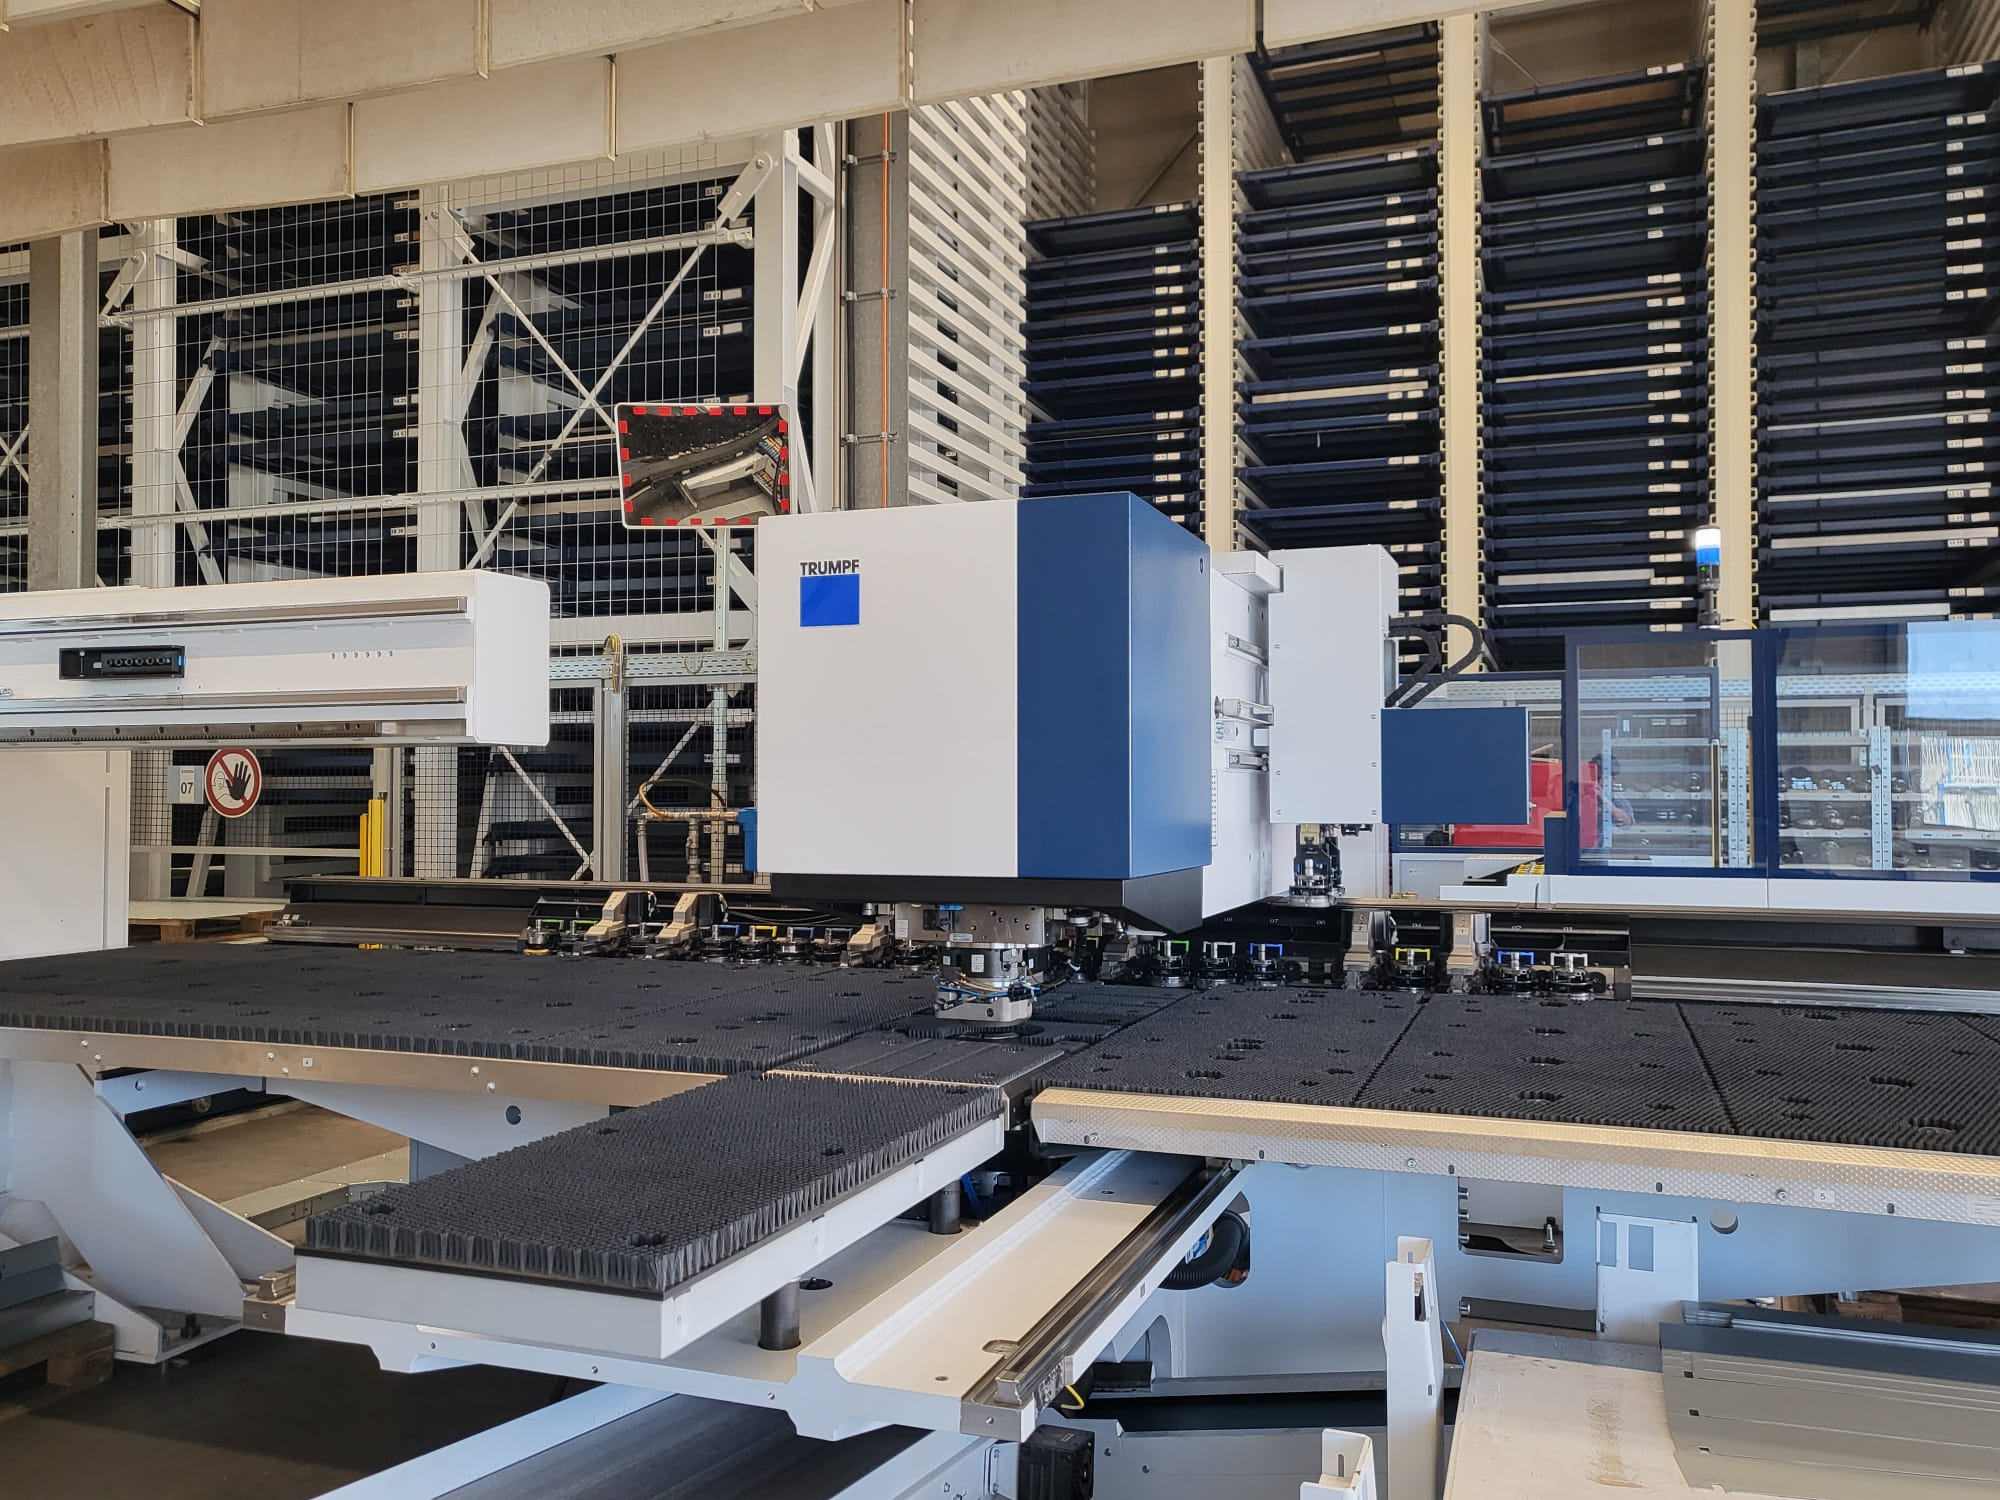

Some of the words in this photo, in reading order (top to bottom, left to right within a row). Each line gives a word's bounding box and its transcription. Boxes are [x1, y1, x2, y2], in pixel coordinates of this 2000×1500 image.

[800, 559, 860, 576] TRUMPF
[180, 782, 194, 794] 07
[1820, 1192, 1826, 1201] 5
